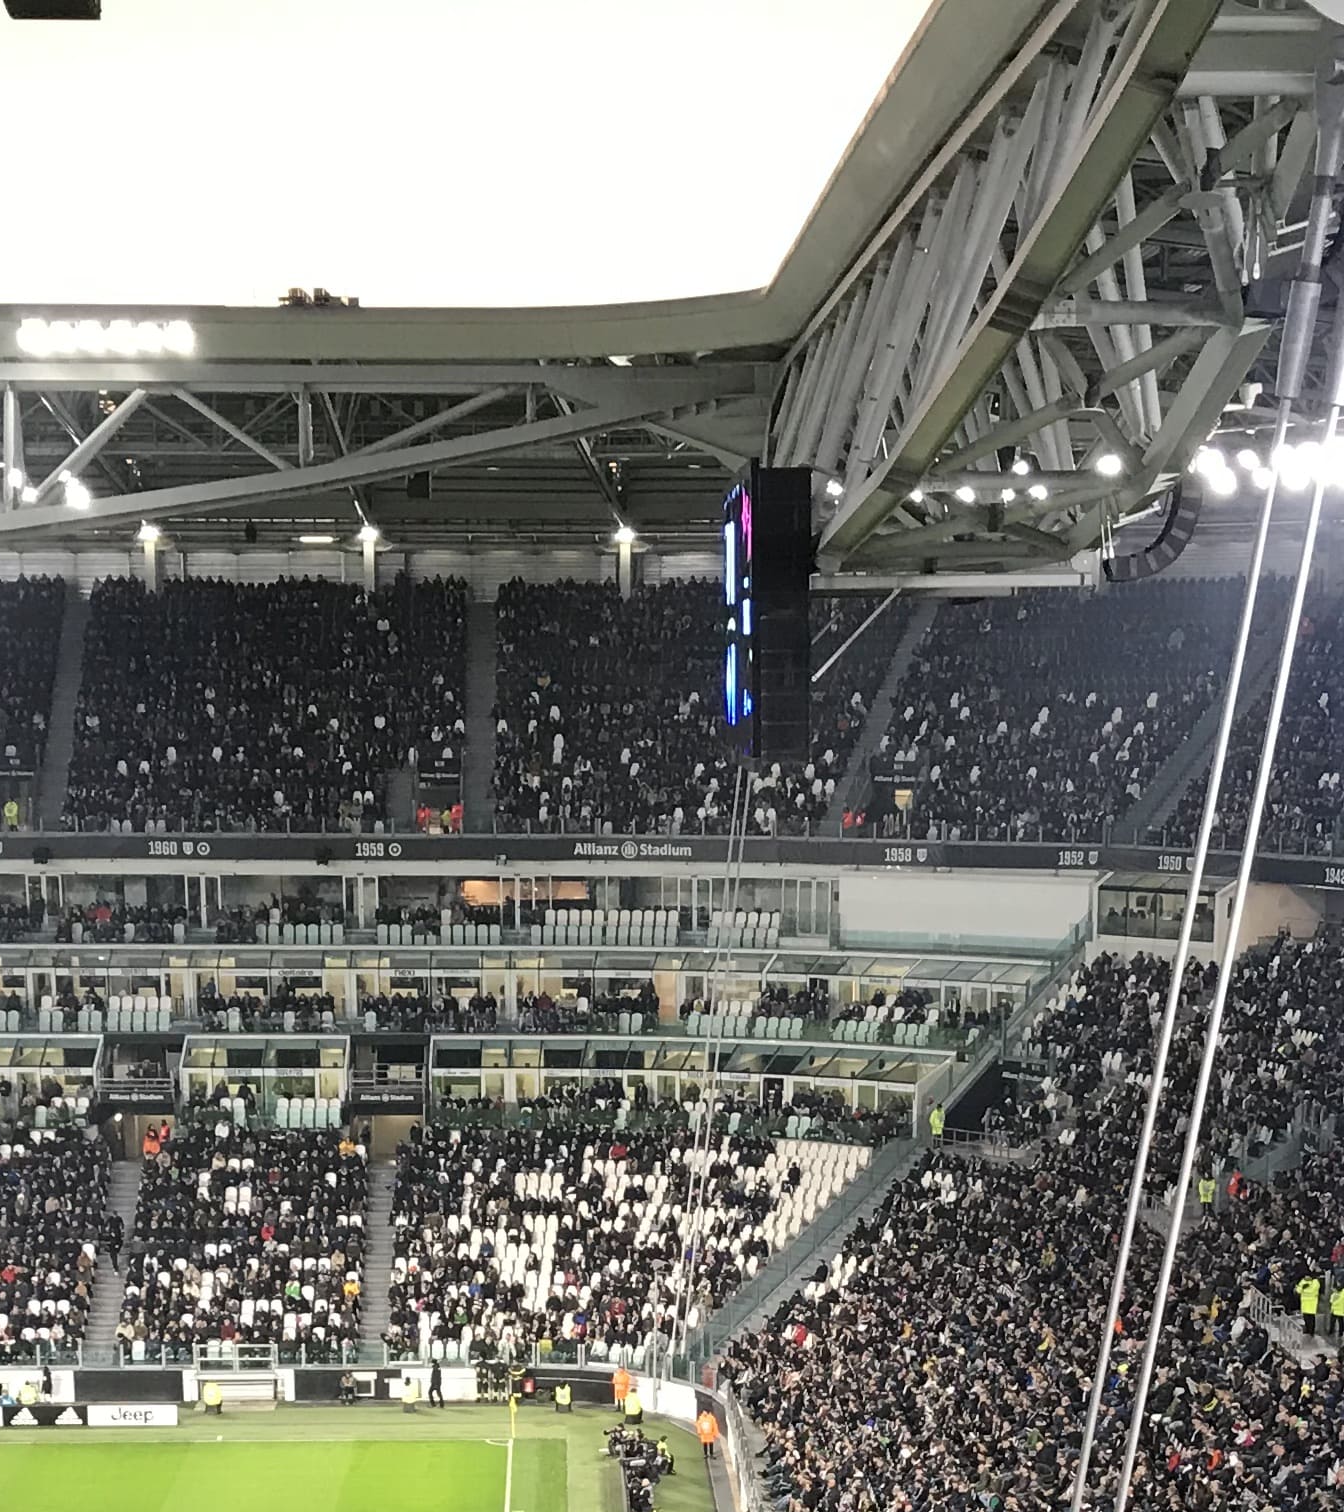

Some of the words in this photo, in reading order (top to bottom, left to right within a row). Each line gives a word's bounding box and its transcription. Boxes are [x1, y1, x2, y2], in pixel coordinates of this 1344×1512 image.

[149, 841, 177, 855] 1960
[356, 843, 384, 856] 1959
[574, 843, 618, 855] Allianz
[640, 844, 691, 856] Stadium
[885, 848, 911, 862] 1958
[1059, 851, 1083, 865] 1952
[1158, 856, 1181, 870] 1950
[111, 1406, 154, 1424] Jeep
